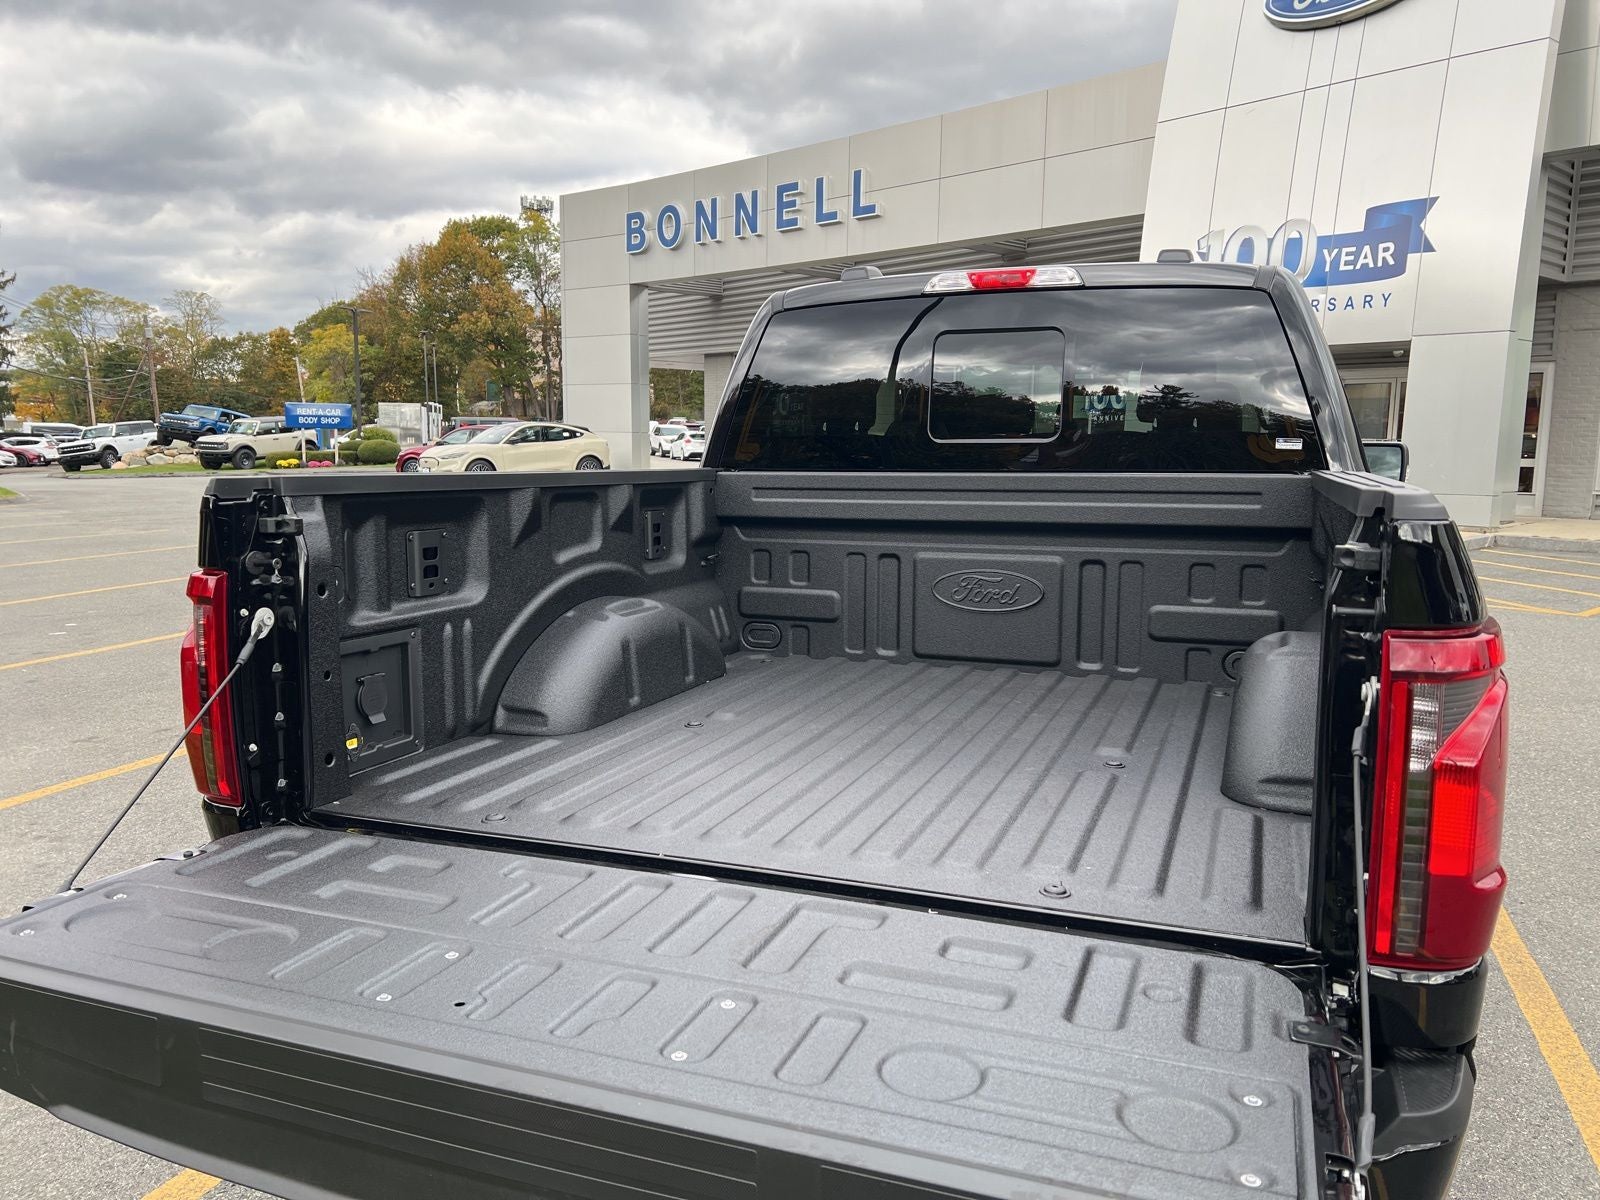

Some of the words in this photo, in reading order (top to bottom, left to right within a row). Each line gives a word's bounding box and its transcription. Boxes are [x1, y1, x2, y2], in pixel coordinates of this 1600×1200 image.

[625, 168, 879, 254] BONNELL
[1323, 241, 1395, 272] YEAR
[296, 407, 342, 416] RENT-A-CAR
[298, 416, 318, 424] BODY
[320, 416, 341, 425] SHOP
[952, 575, 1021, 604] Ford
